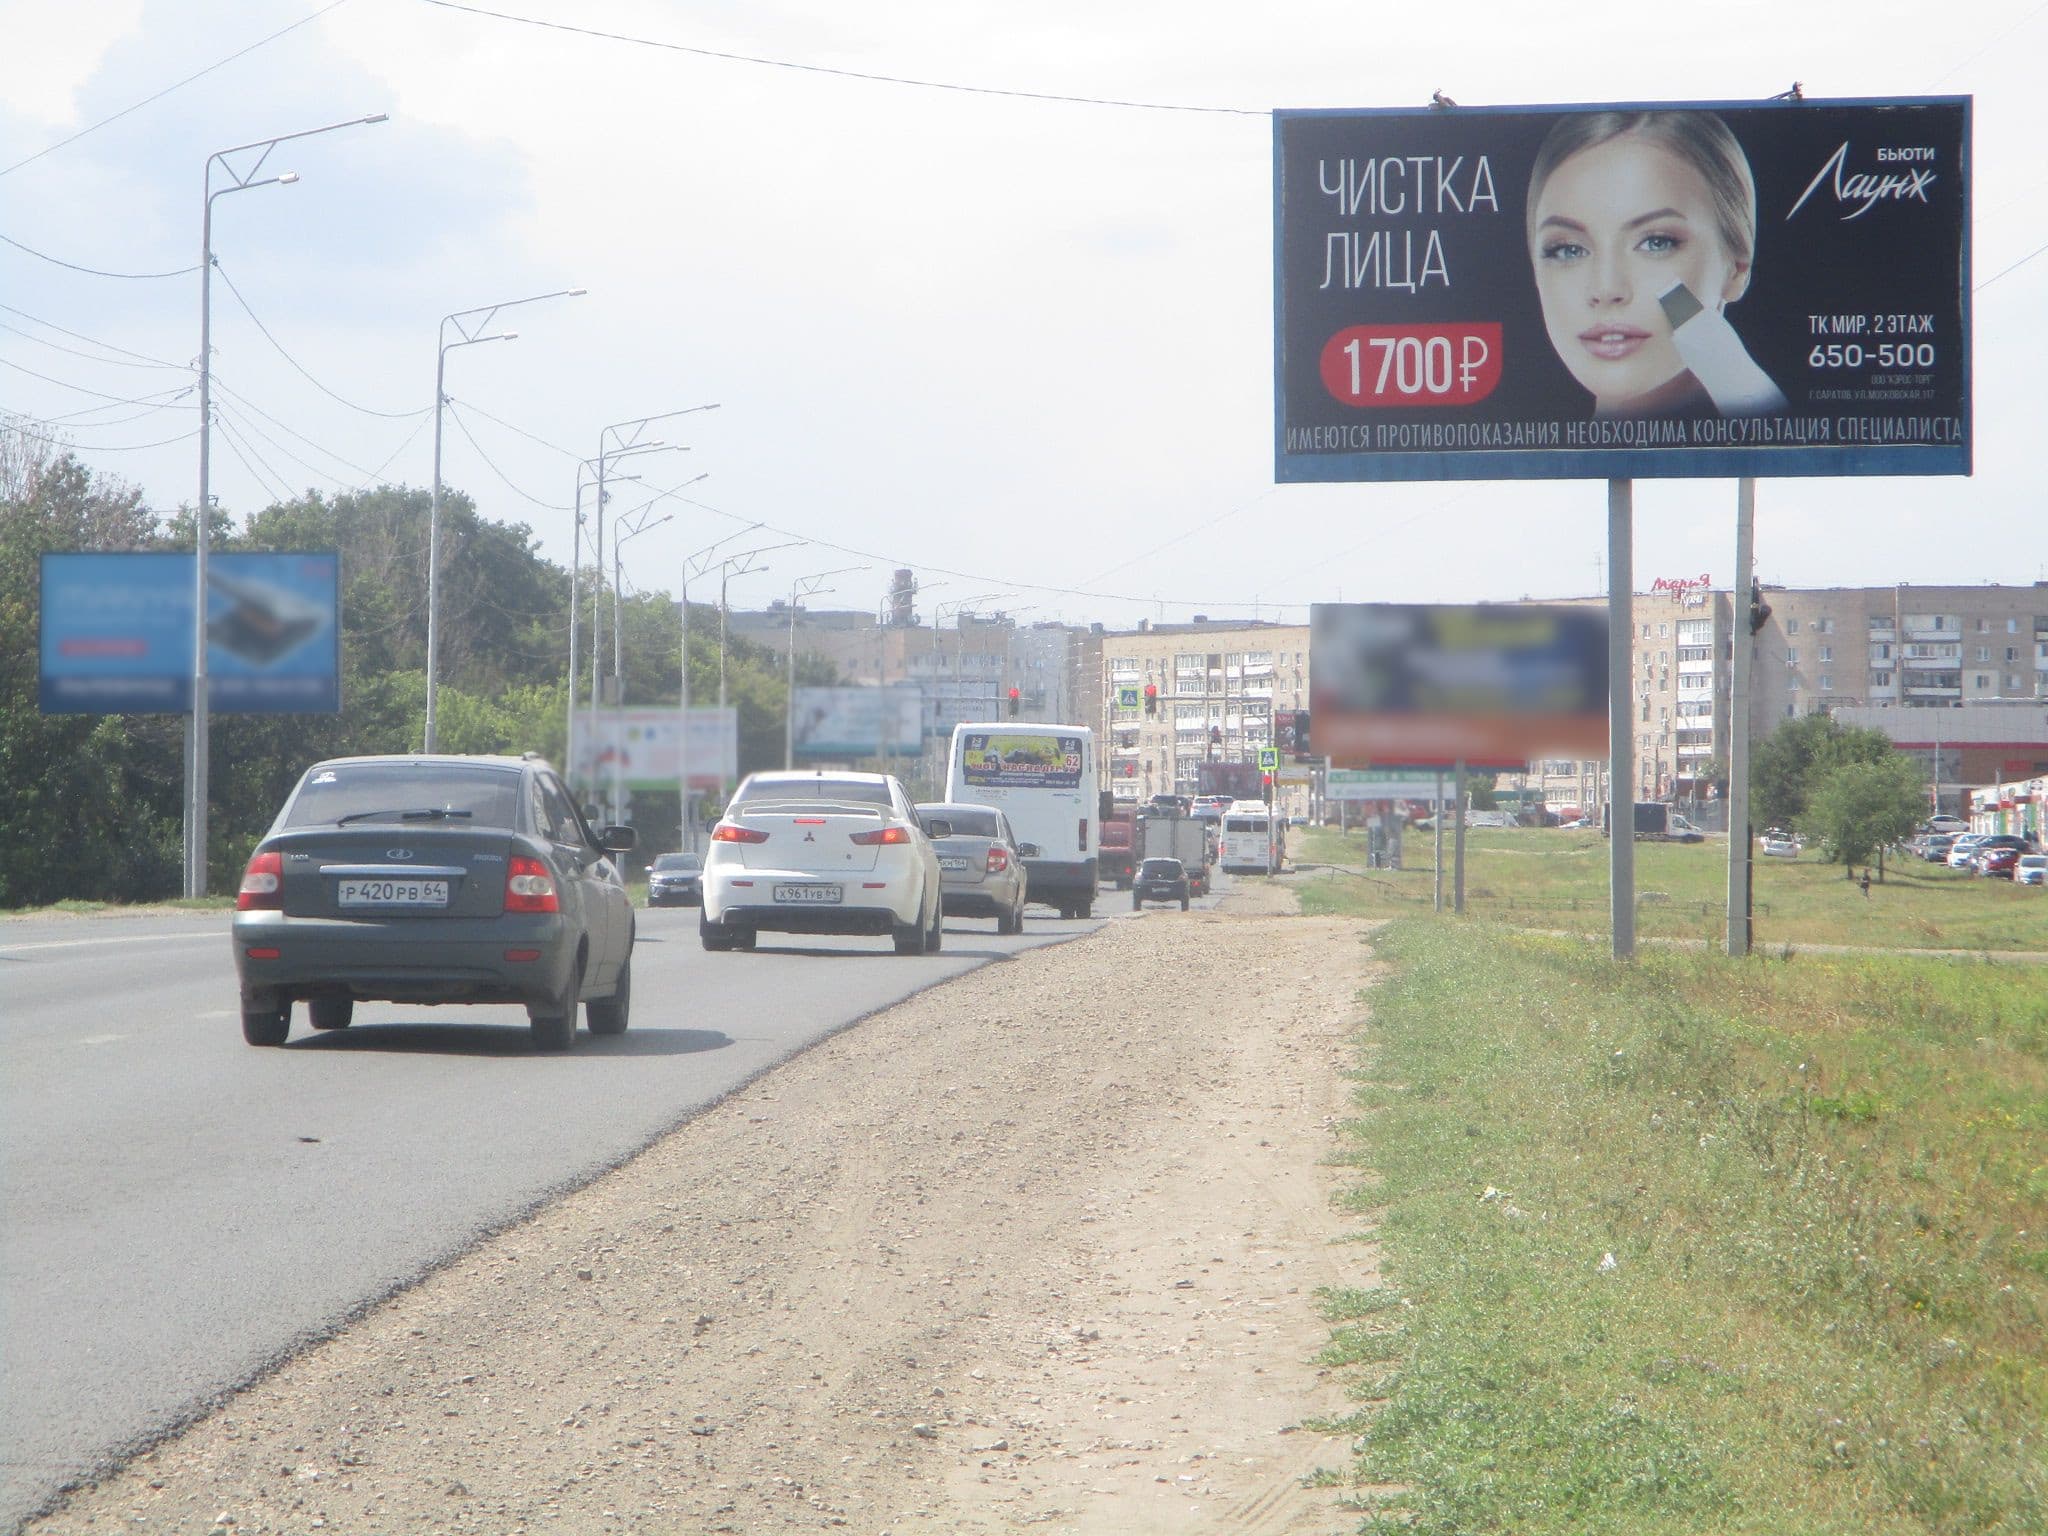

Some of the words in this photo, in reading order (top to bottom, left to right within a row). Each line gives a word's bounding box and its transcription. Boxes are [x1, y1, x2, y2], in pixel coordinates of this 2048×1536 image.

[1877, 147, 1935, 161] БЬЮТИ
[1319, 155, 1499, 216] ЧИСТКА
[1785, 140, 1937, 220] Лаунж
[1319, 229, 1450, 294] ЛИЦА
[1808, 314, 1829, 334] ТК
[1832, 314, 1870, 335] МИР,
[1874, 314, 1884, 333] 2
[1887, 314, 1934, 334] ЭТАЖ
[1808, 343, 1935, 367] 650-500
[1286, 425, 1370, 450] ИМЕЮТСЯ
[1376, 421, 1560, 449] ПРОТИВОПОКАЗАНИЯ
[1566, 419, 1687, 447] НЕОБХОДИМА
[1693, 417, 1830, 445] КОНСУЛЬТАЦИЯ
[1837, 416, 1962, 443] СПЕЦИАЛИСТА
[1066, 755, 1078, 767] 62
